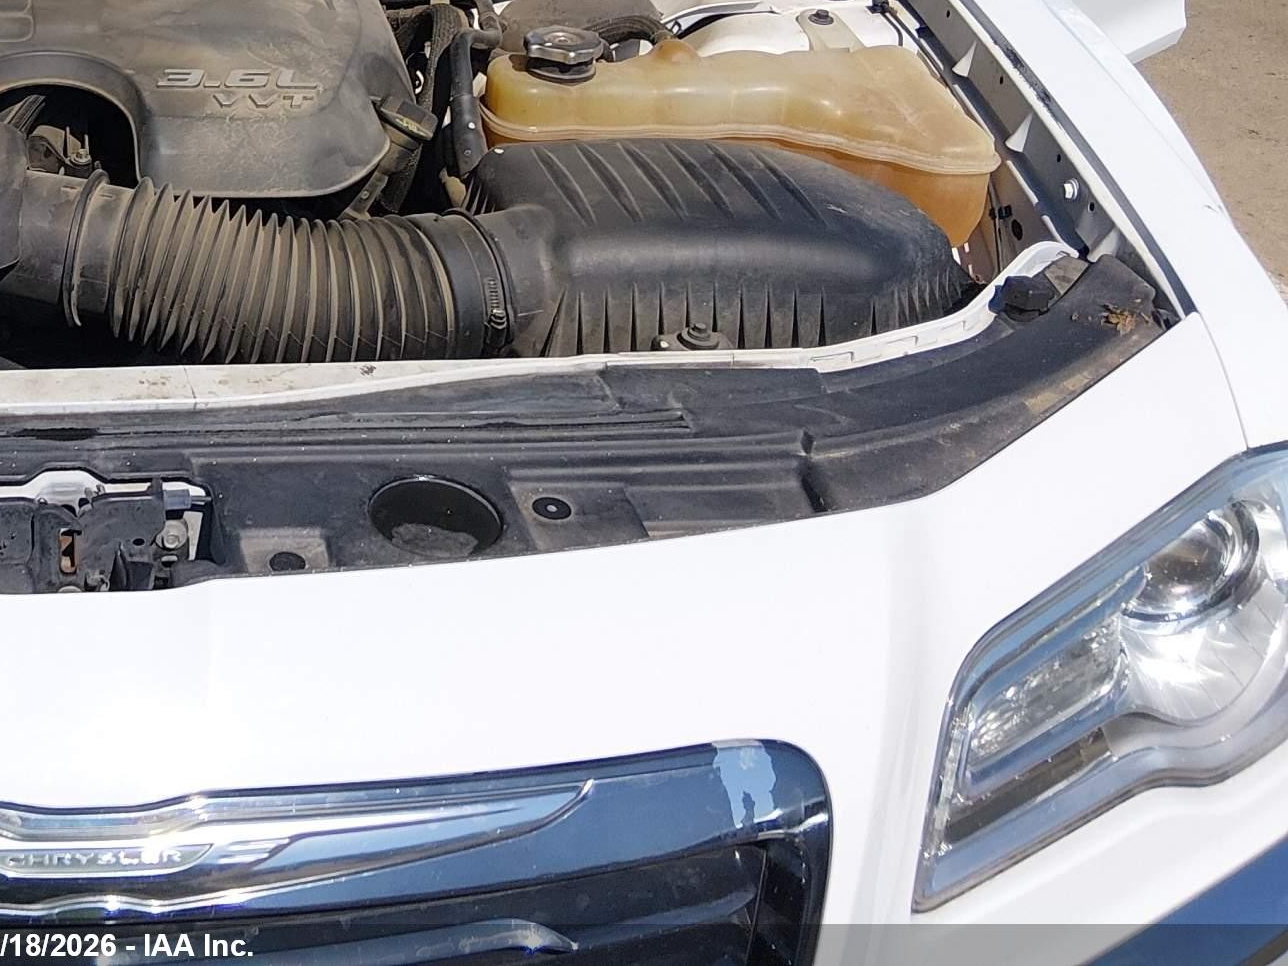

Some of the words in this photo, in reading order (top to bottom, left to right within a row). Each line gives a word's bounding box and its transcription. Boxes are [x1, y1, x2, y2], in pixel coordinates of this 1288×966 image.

[156, 68, 319, 90] 3.6L
[213, 93, 313, 109] VVT
[7, 849, 182, 867] CHRYSLER
